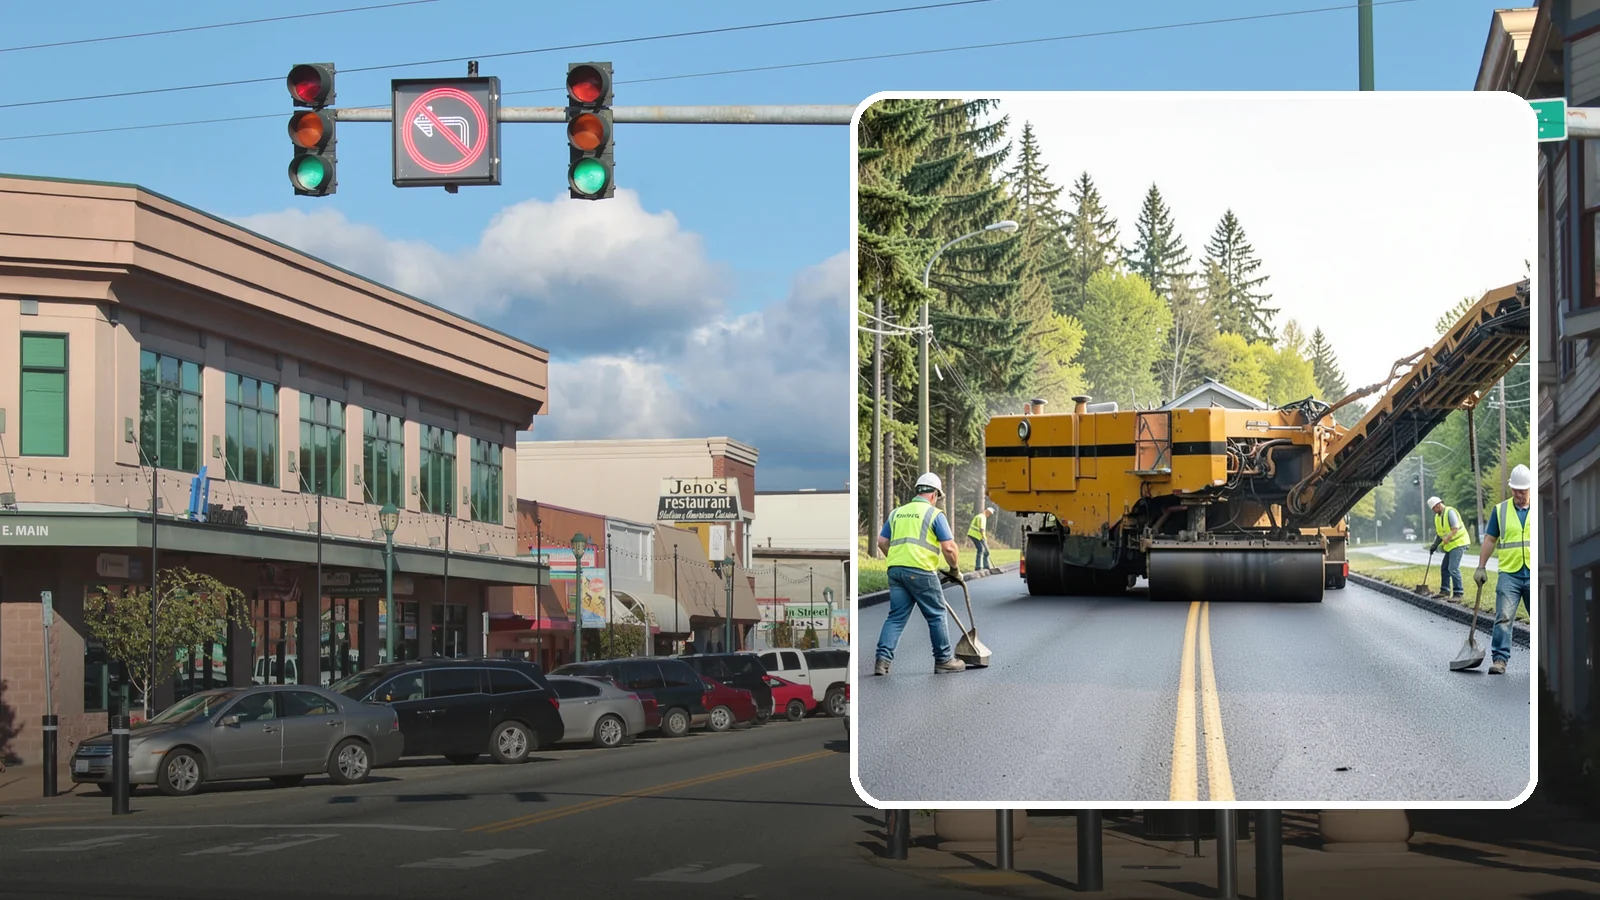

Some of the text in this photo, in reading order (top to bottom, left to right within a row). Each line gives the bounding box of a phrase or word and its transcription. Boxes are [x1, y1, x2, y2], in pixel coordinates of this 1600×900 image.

[670, 480, 727, 494] Jeno's
[665, 496, 731, 509] restaurant
[658, 509, 681, 519] Italian
[686, 509, 714, 519] American
[715, 509, 738, 519] Cuisine
[2, 525, 49, 536] E. MAIN
[797, 607, 828, 617] Street
